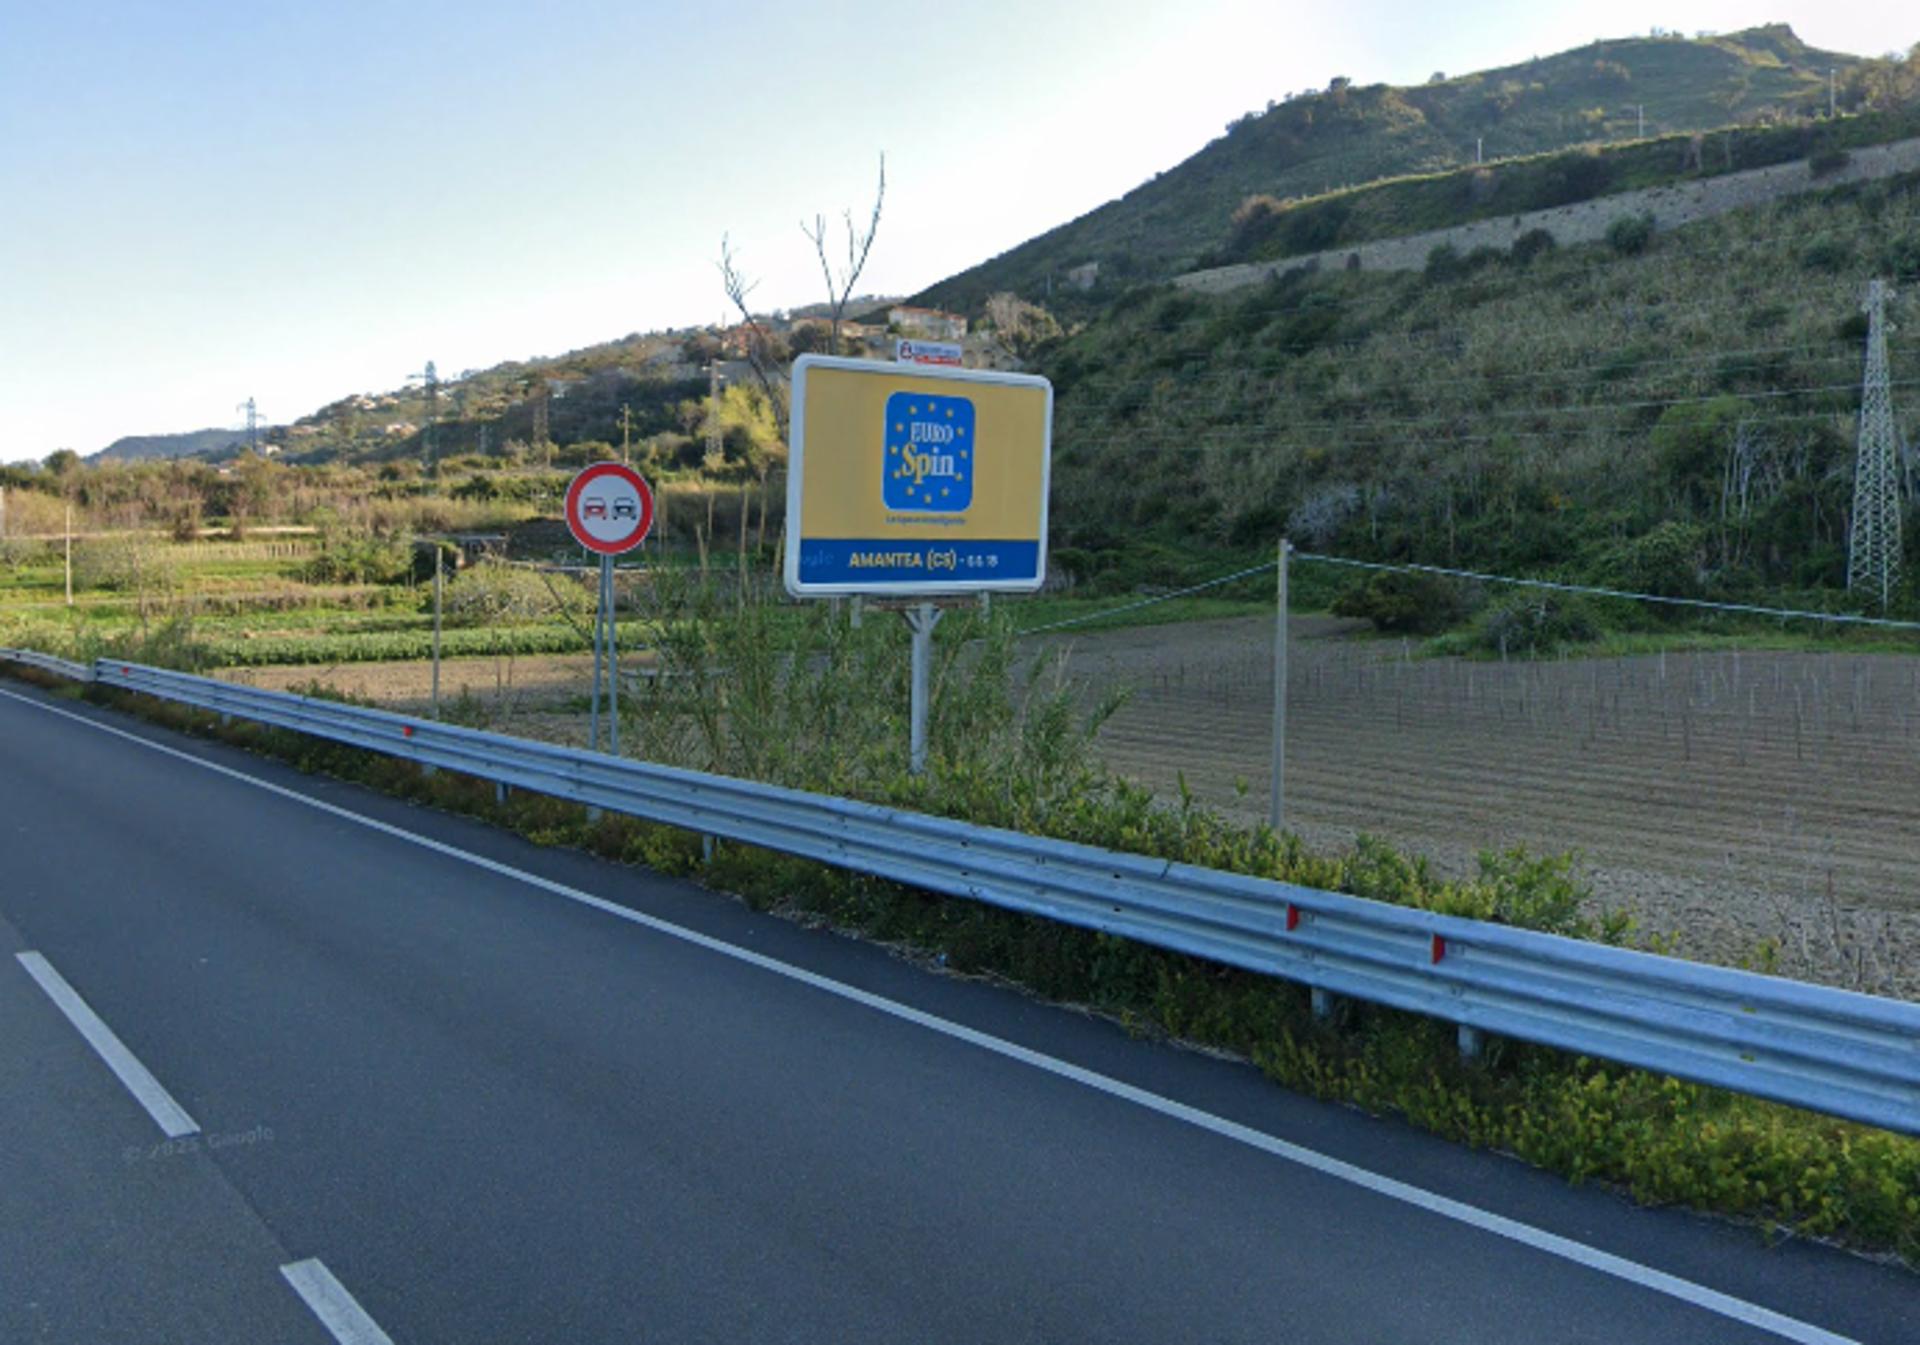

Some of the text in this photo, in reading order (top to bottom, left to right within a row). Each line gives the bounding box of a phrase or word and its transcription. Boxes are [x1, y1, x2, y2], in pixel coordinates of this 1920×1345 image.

[910, 421, 955, 444] EURO
[901, 440, 955, 485] Spin
[849, 551, 923, 569] AMANTEA
[927, 548, 957, 571] (CS)
